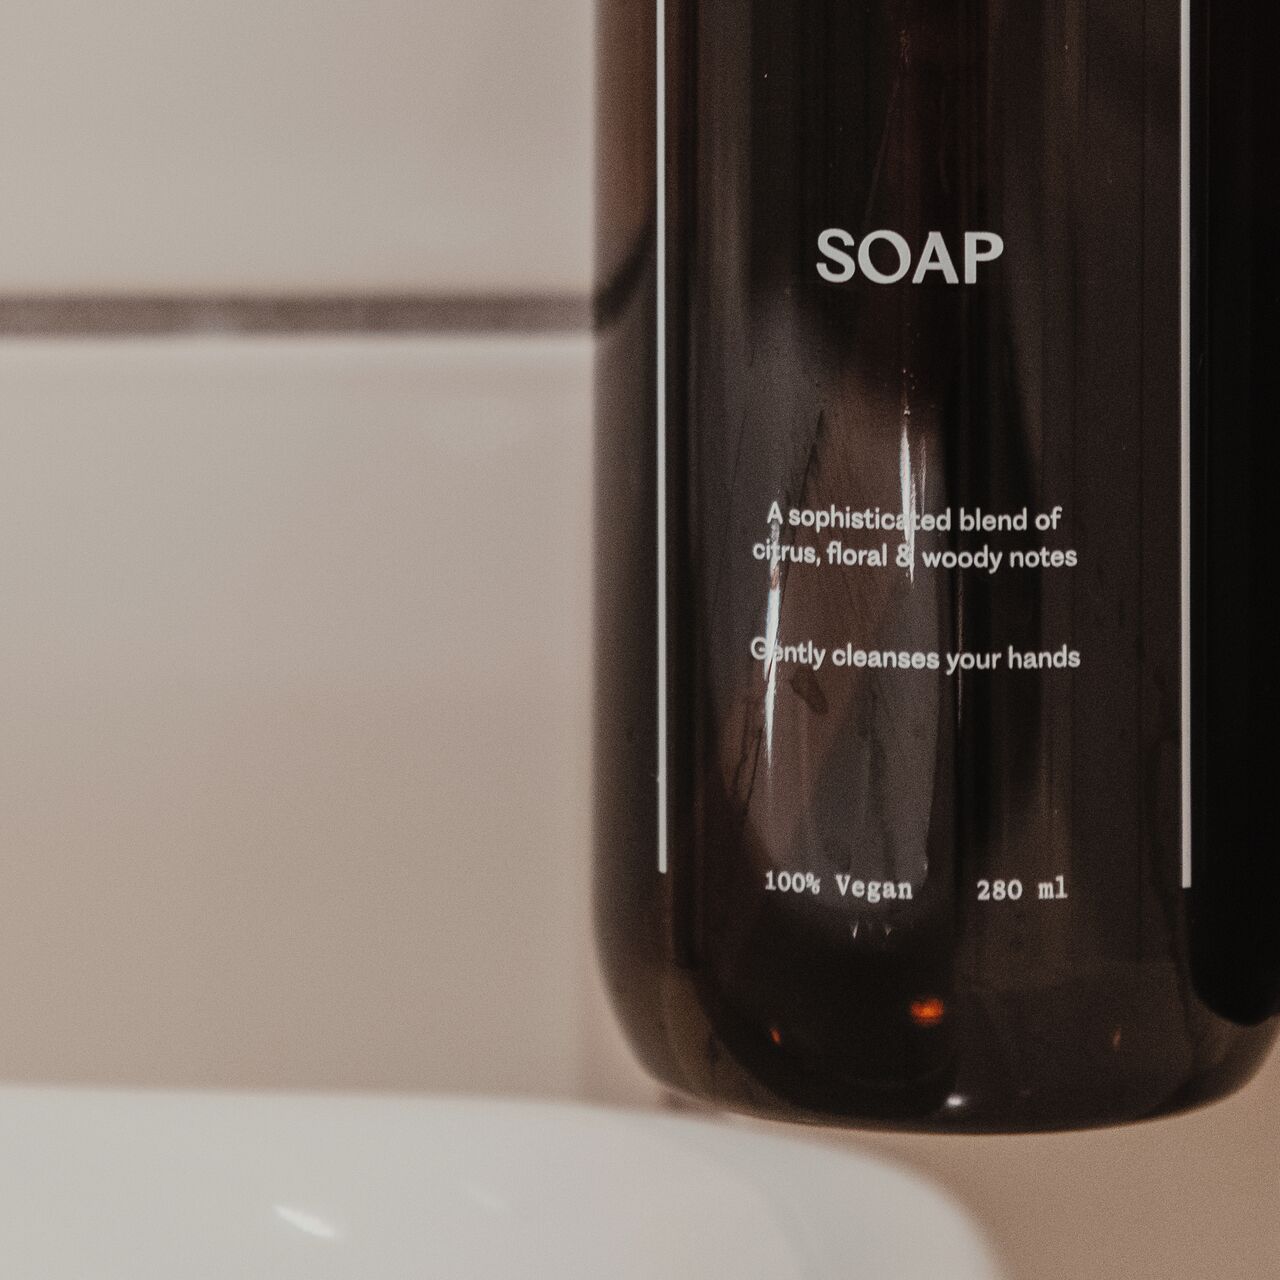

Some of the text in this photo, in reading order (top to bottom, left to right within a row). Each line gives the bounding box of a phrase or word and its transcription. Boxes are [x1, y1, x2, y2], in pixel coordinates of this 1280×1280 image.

[815, 227, 1005, 285] SOAP
[766, 500, 1063, 533] A sophisticated blend of
[752, 538, 1078, 574] citrus, floral & woody notes
[750, 636, 1081, 676] Gently cleanses your hands
[764, 870, 913, 904] 100% Vegan
[976, 875, 1069, 901] 280 ml
